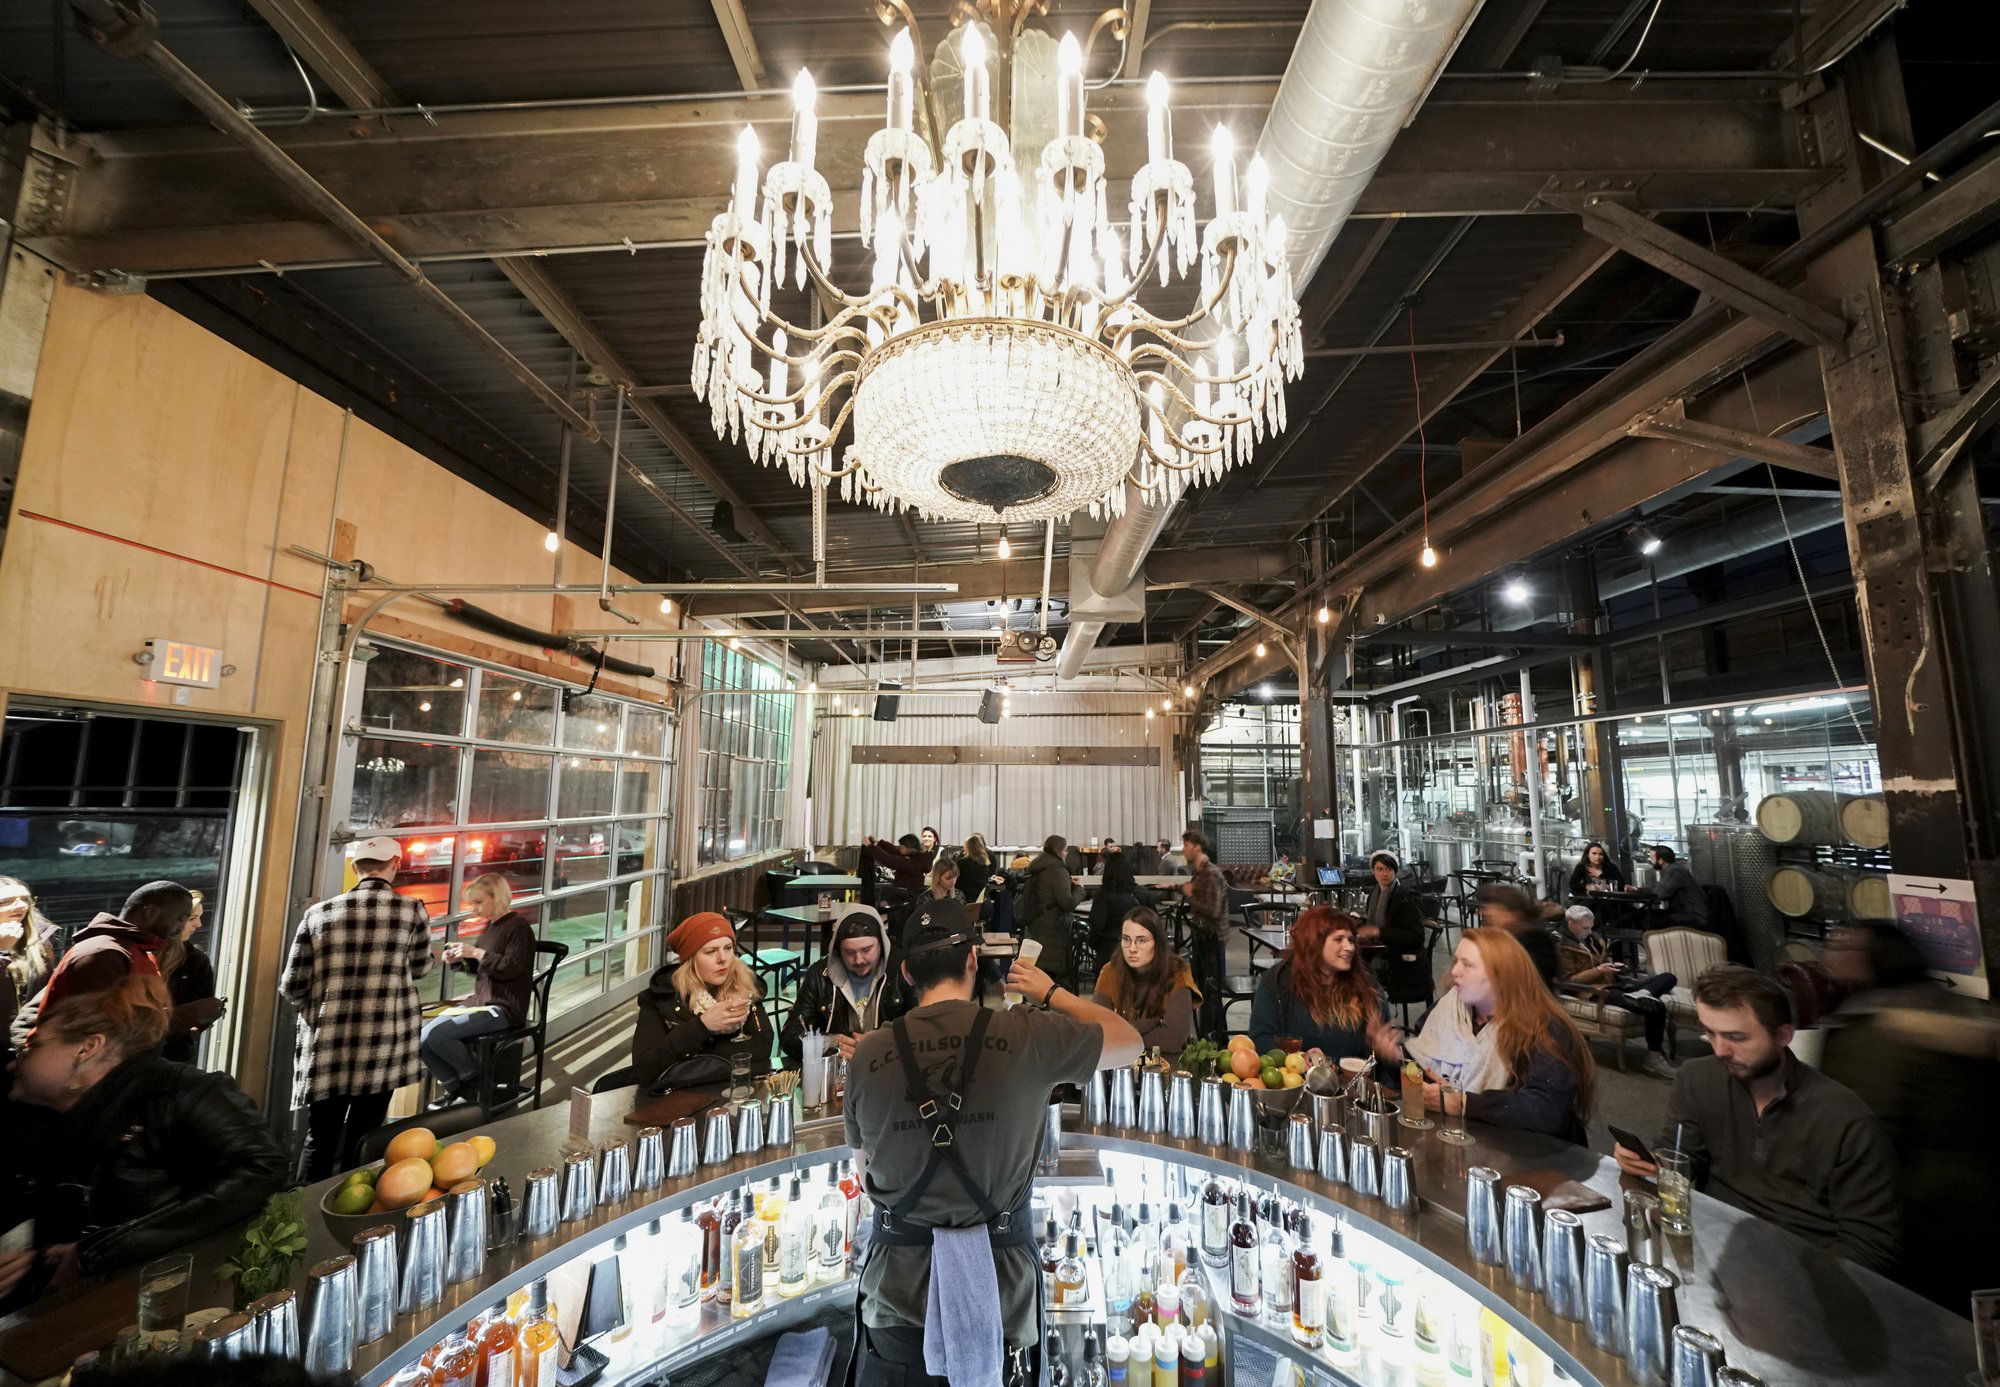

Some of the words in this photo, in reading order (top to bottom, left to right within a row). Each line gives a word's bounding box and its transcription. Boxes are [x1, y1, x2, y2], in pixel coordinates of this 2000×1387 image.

[163, 642, 216, 682] EXIT
[869, 1050, 900, 1073] C.C.
[910, 1035, 969, 1056] FILSO
[984, 1036, 1012, 1054] CO.
